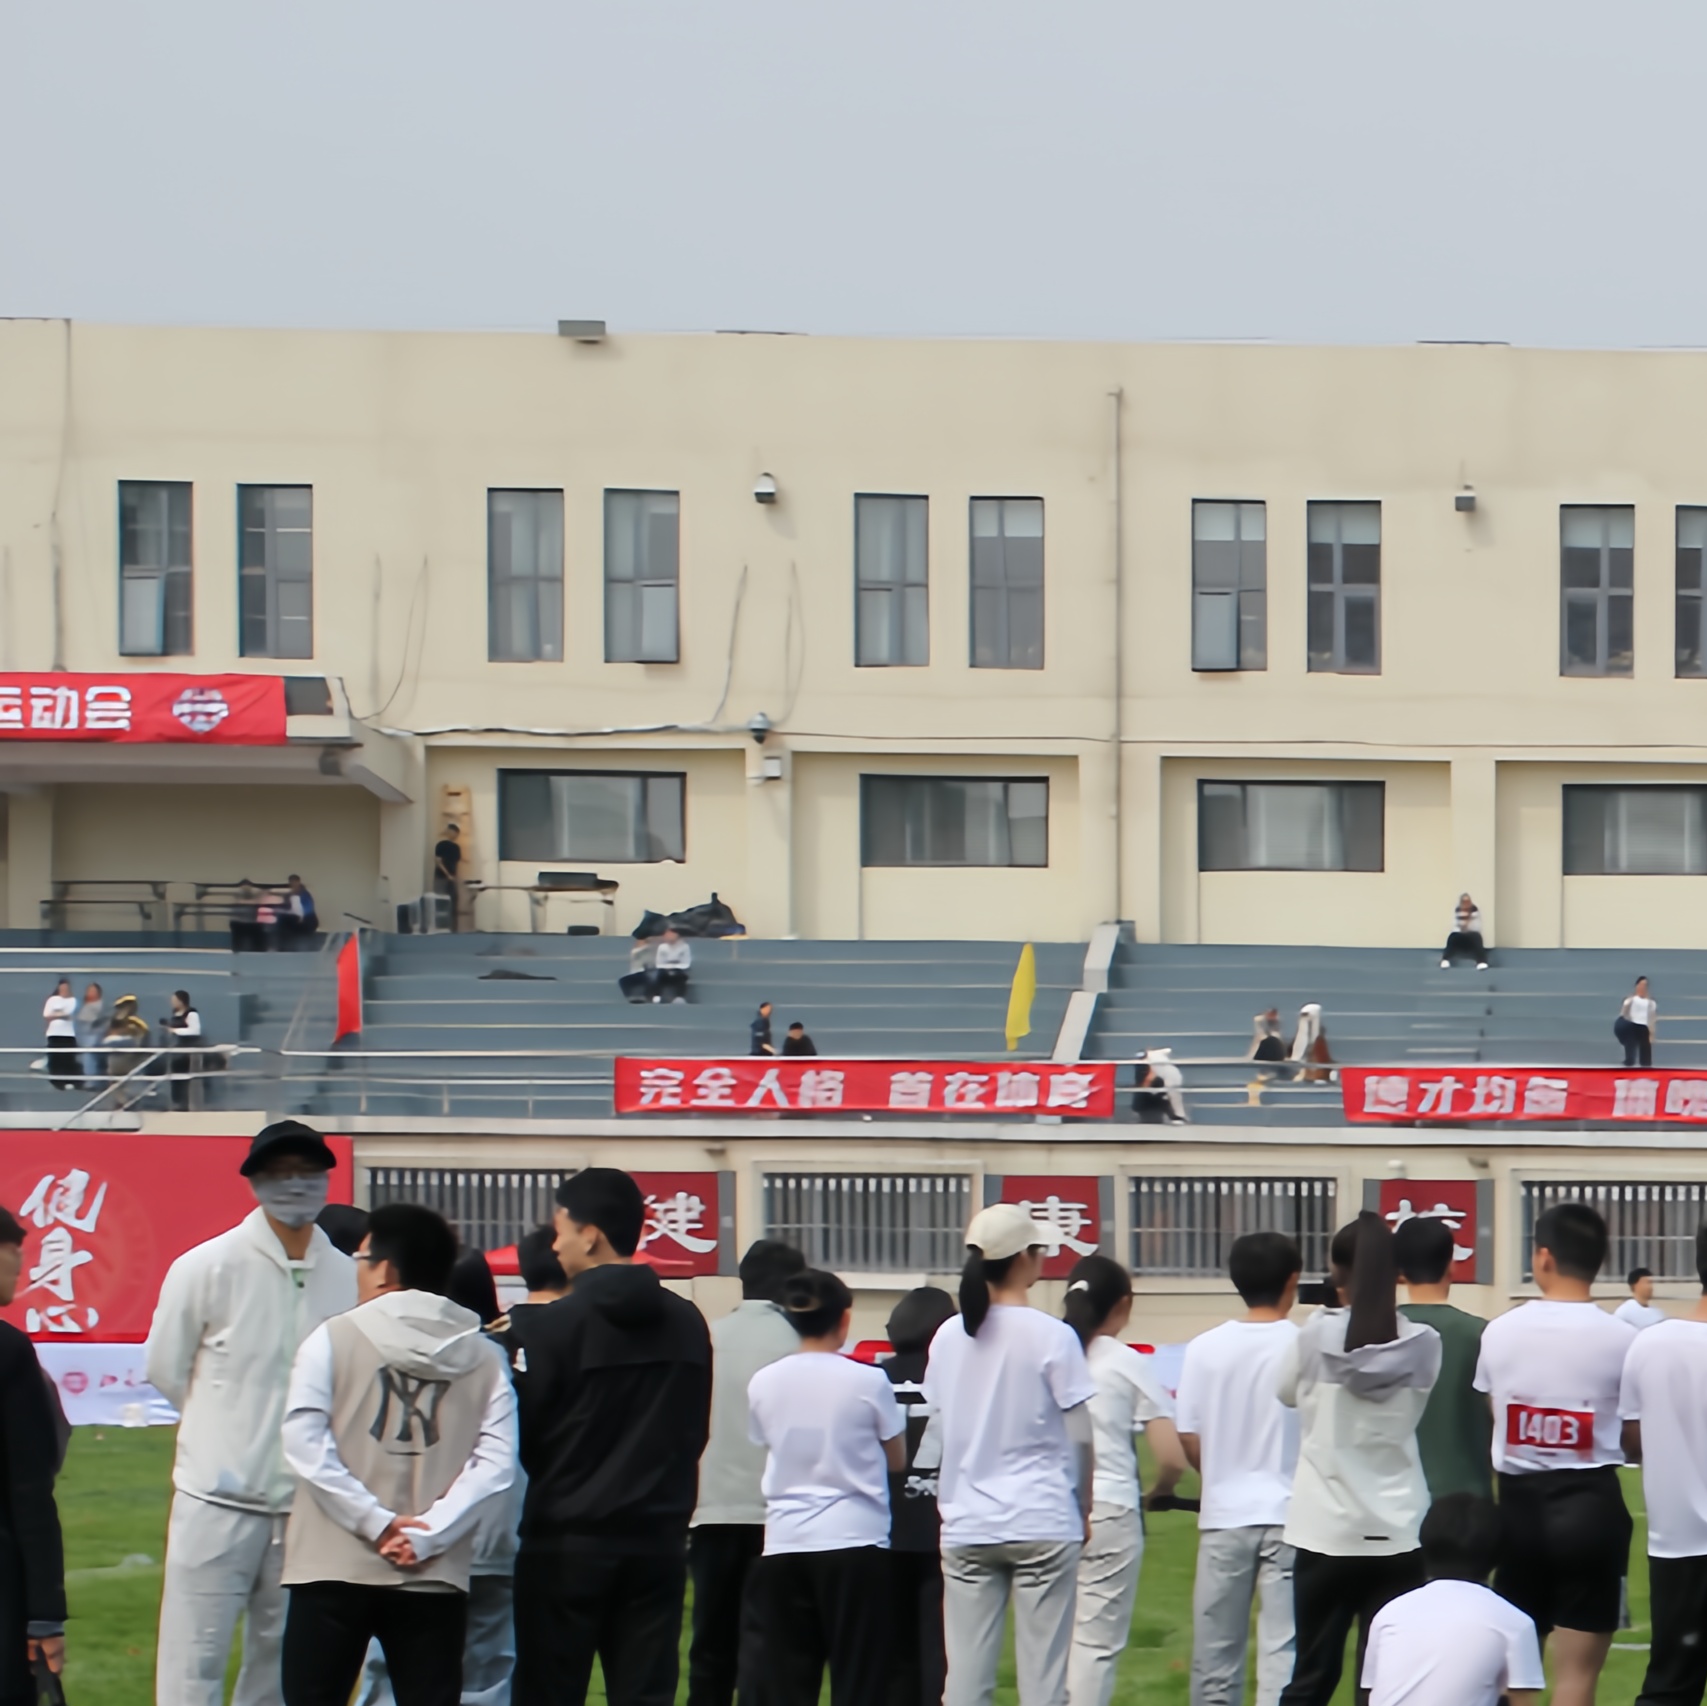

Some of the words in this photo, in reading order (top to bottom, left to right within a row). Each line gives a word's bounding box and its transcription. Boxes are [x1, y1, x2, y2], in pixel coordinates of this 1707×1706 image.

[639, 1067, 846, 1108] 完全人格
[1519, 1411, 1580, 1445] 1403
